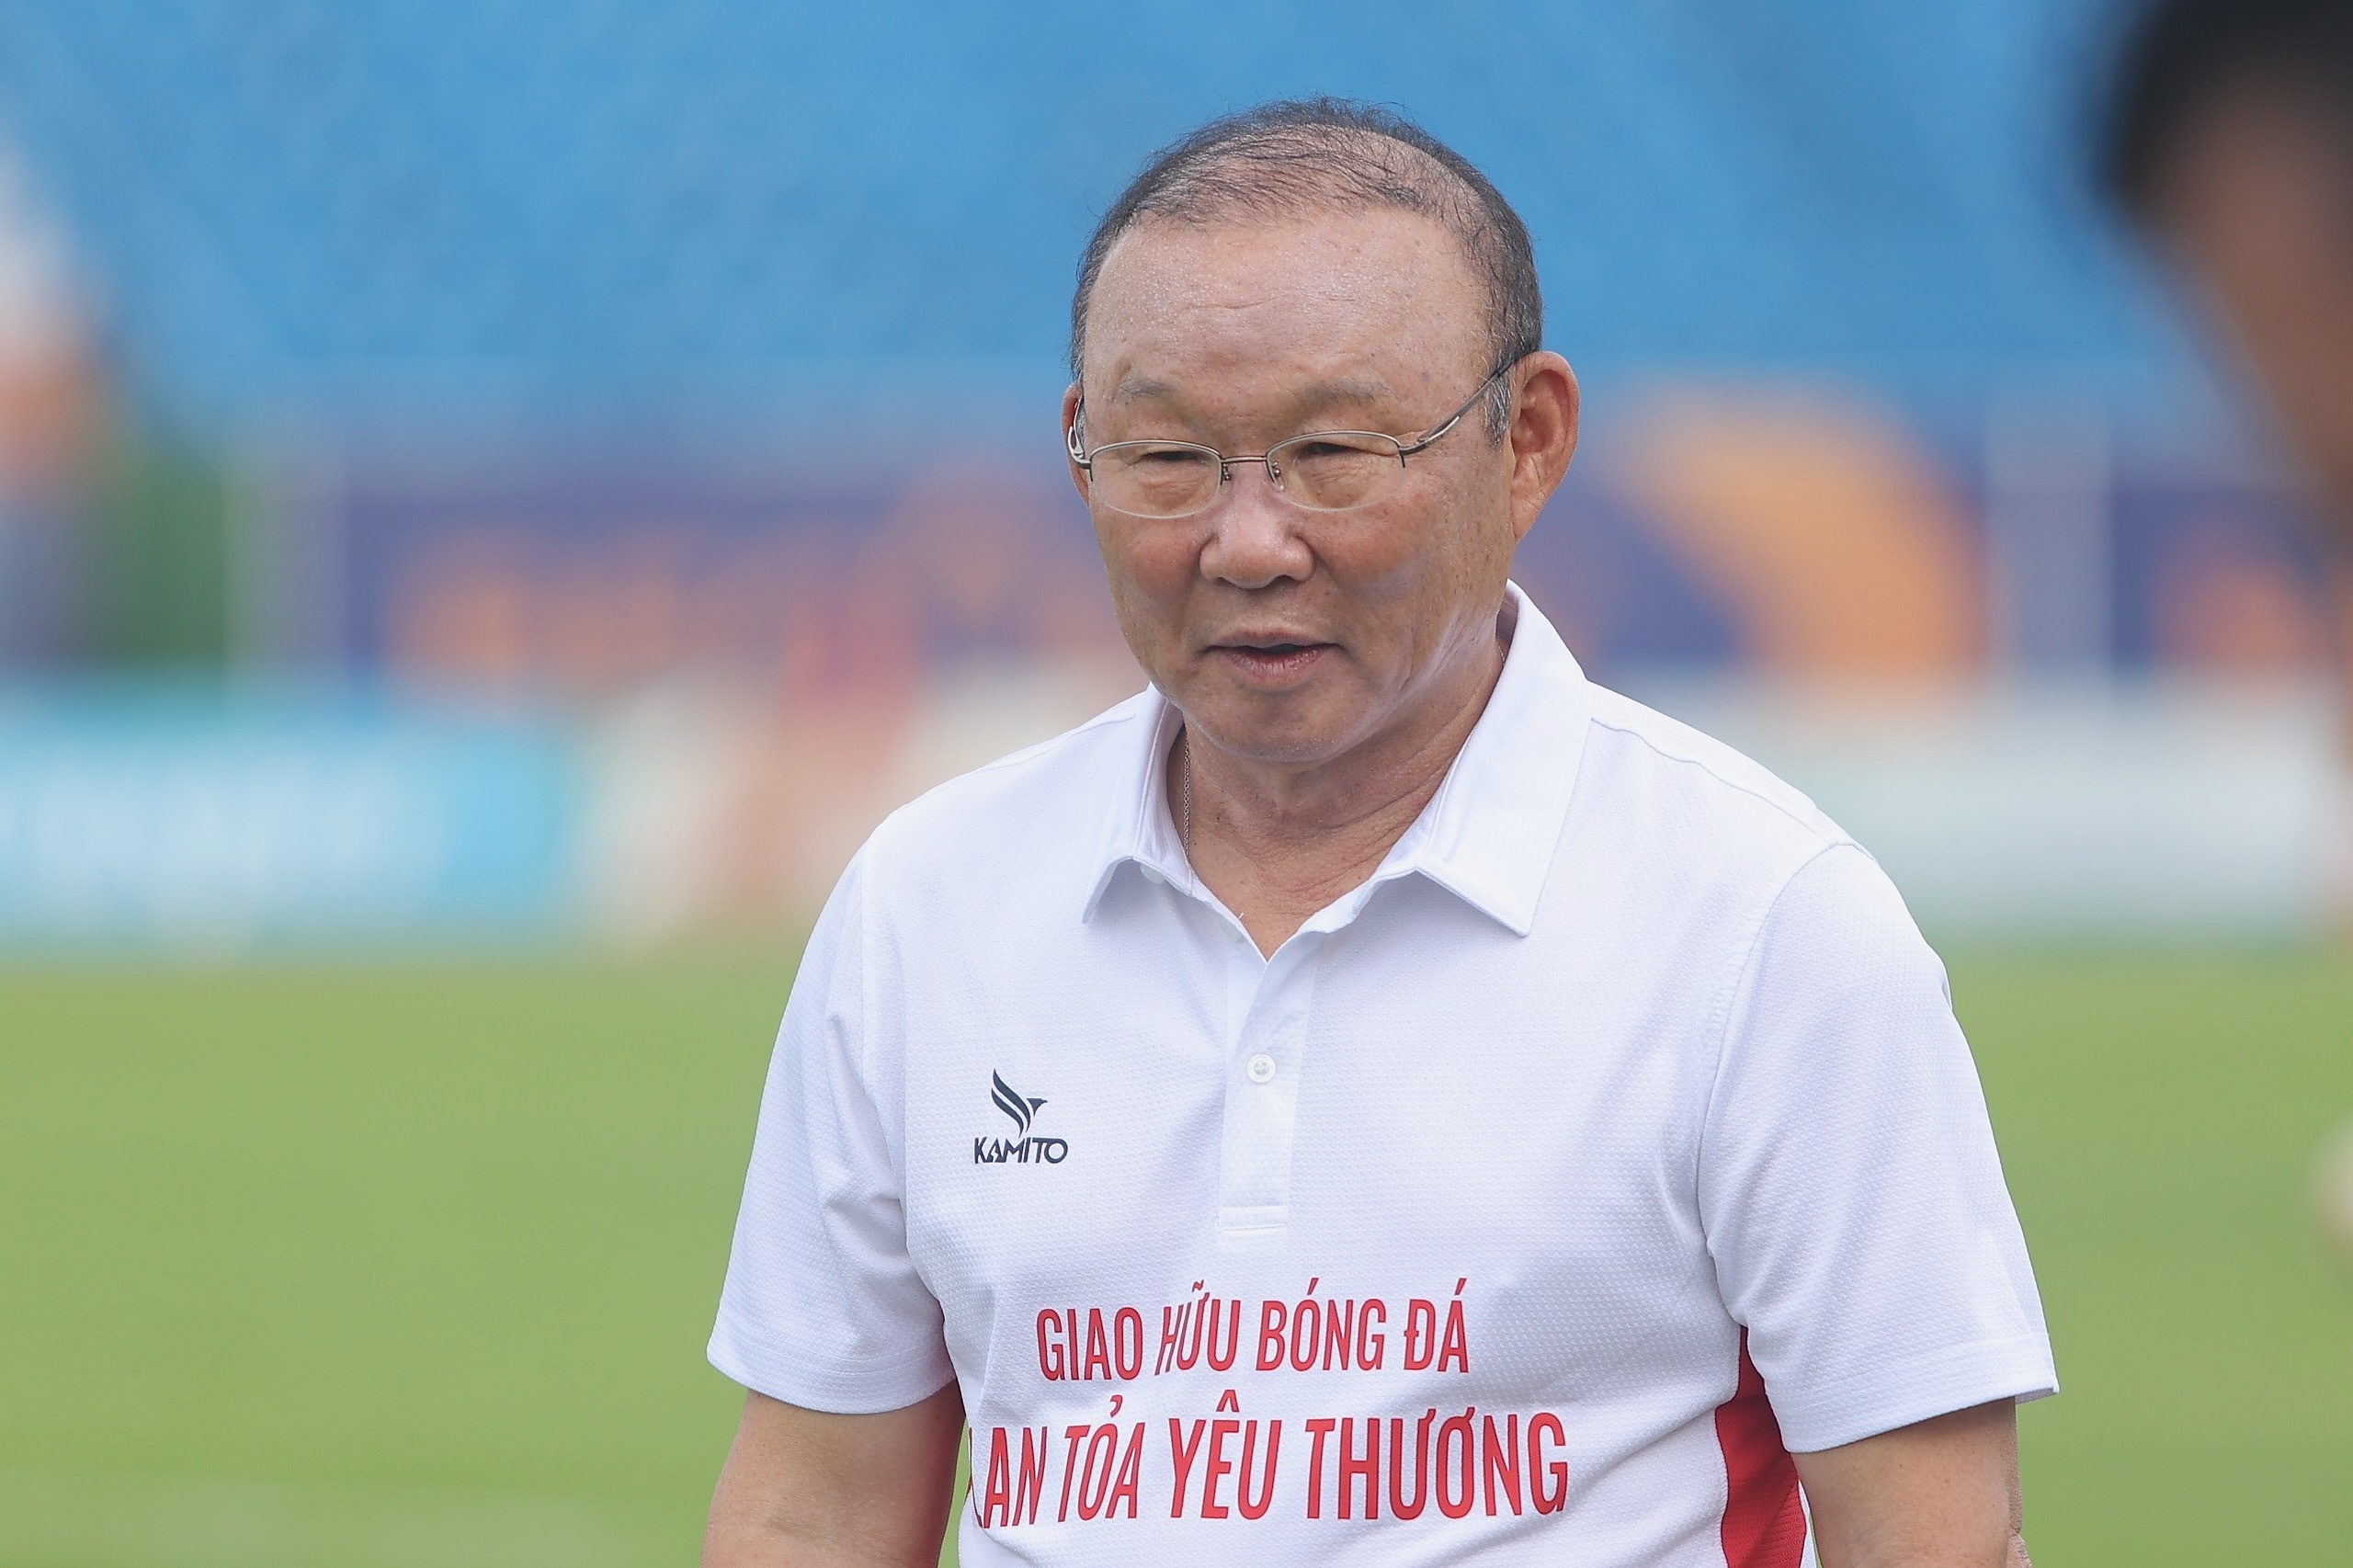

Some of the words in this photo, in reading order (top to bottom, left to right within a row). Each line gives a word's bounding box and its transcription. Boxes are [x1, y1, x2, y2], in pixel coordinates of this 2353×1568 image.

[974, 1137, 1068, 1164] KAMITO
[1036, 1306, 1144, 1381] GIAO
[1154, 1281, 1242, 1376] HỮU
[1256, 1277, 1387, 1372] BÓNG
[1404, 1278, 1471, 1373] ĐÁ
[1058, 1394, 1146, 1523] TỎA
[1169, 1389, 1283, 1521] YÊU
[1305, 1406, 1569, 1521] THƯƠNG
